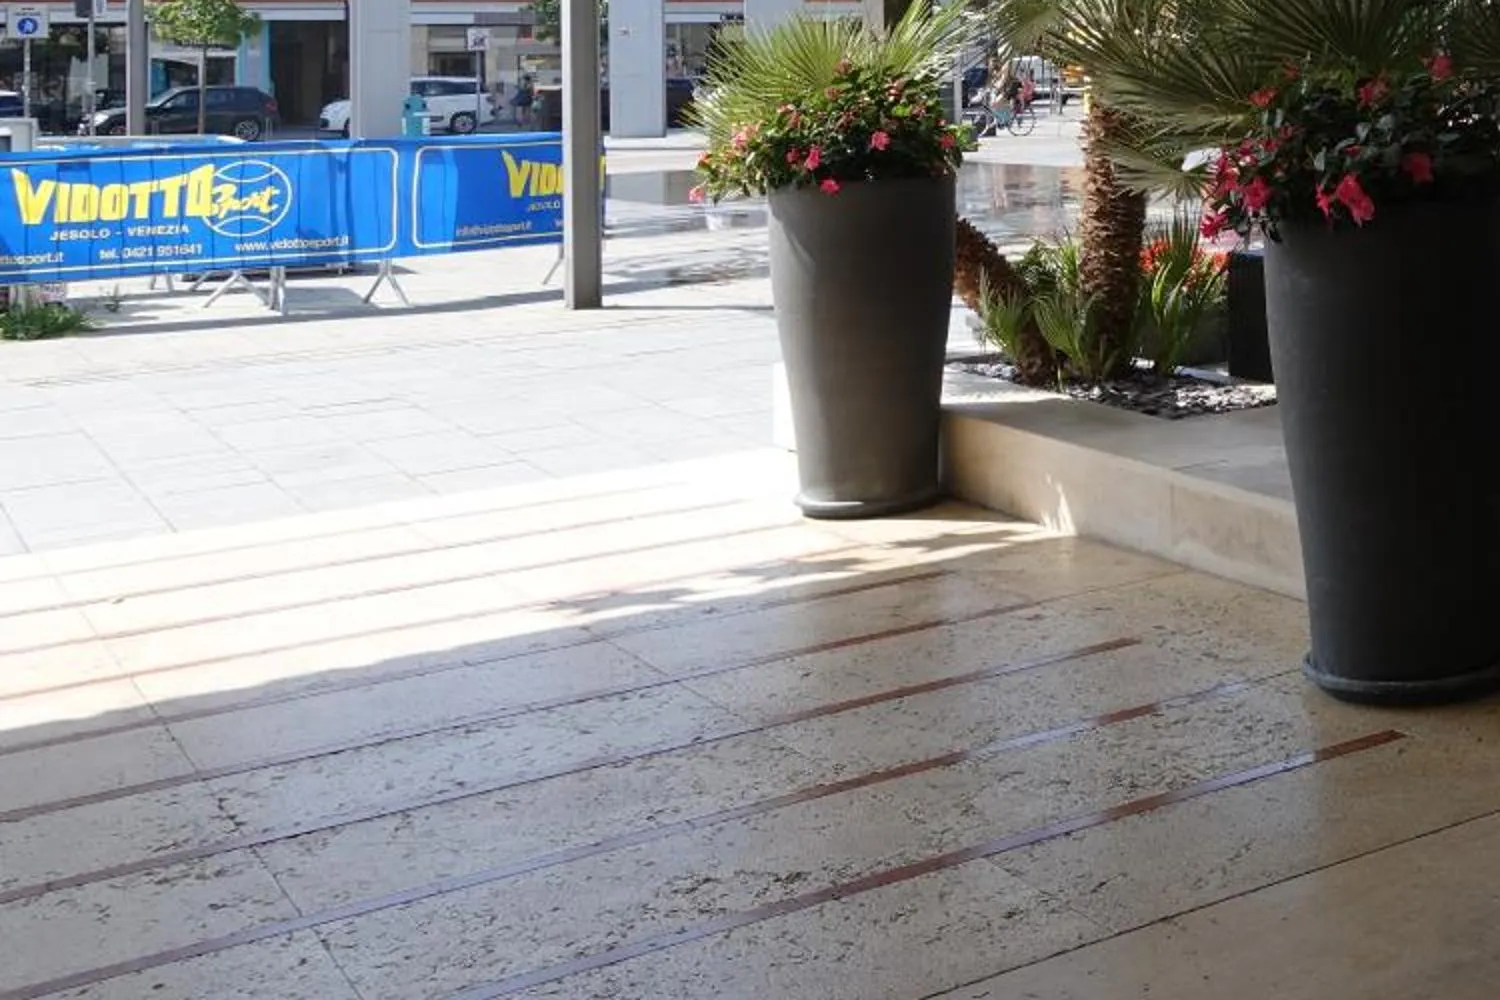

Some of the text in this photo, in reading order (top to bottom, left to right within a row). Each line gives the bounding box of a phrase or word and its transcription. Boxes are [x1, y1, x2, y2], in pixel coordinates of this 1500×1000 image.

[11, 163, 215, 225] VIDOTTO
[50, 228, 111, 241] JESOLO
[127, 225, 190, 238] VENEZIA
